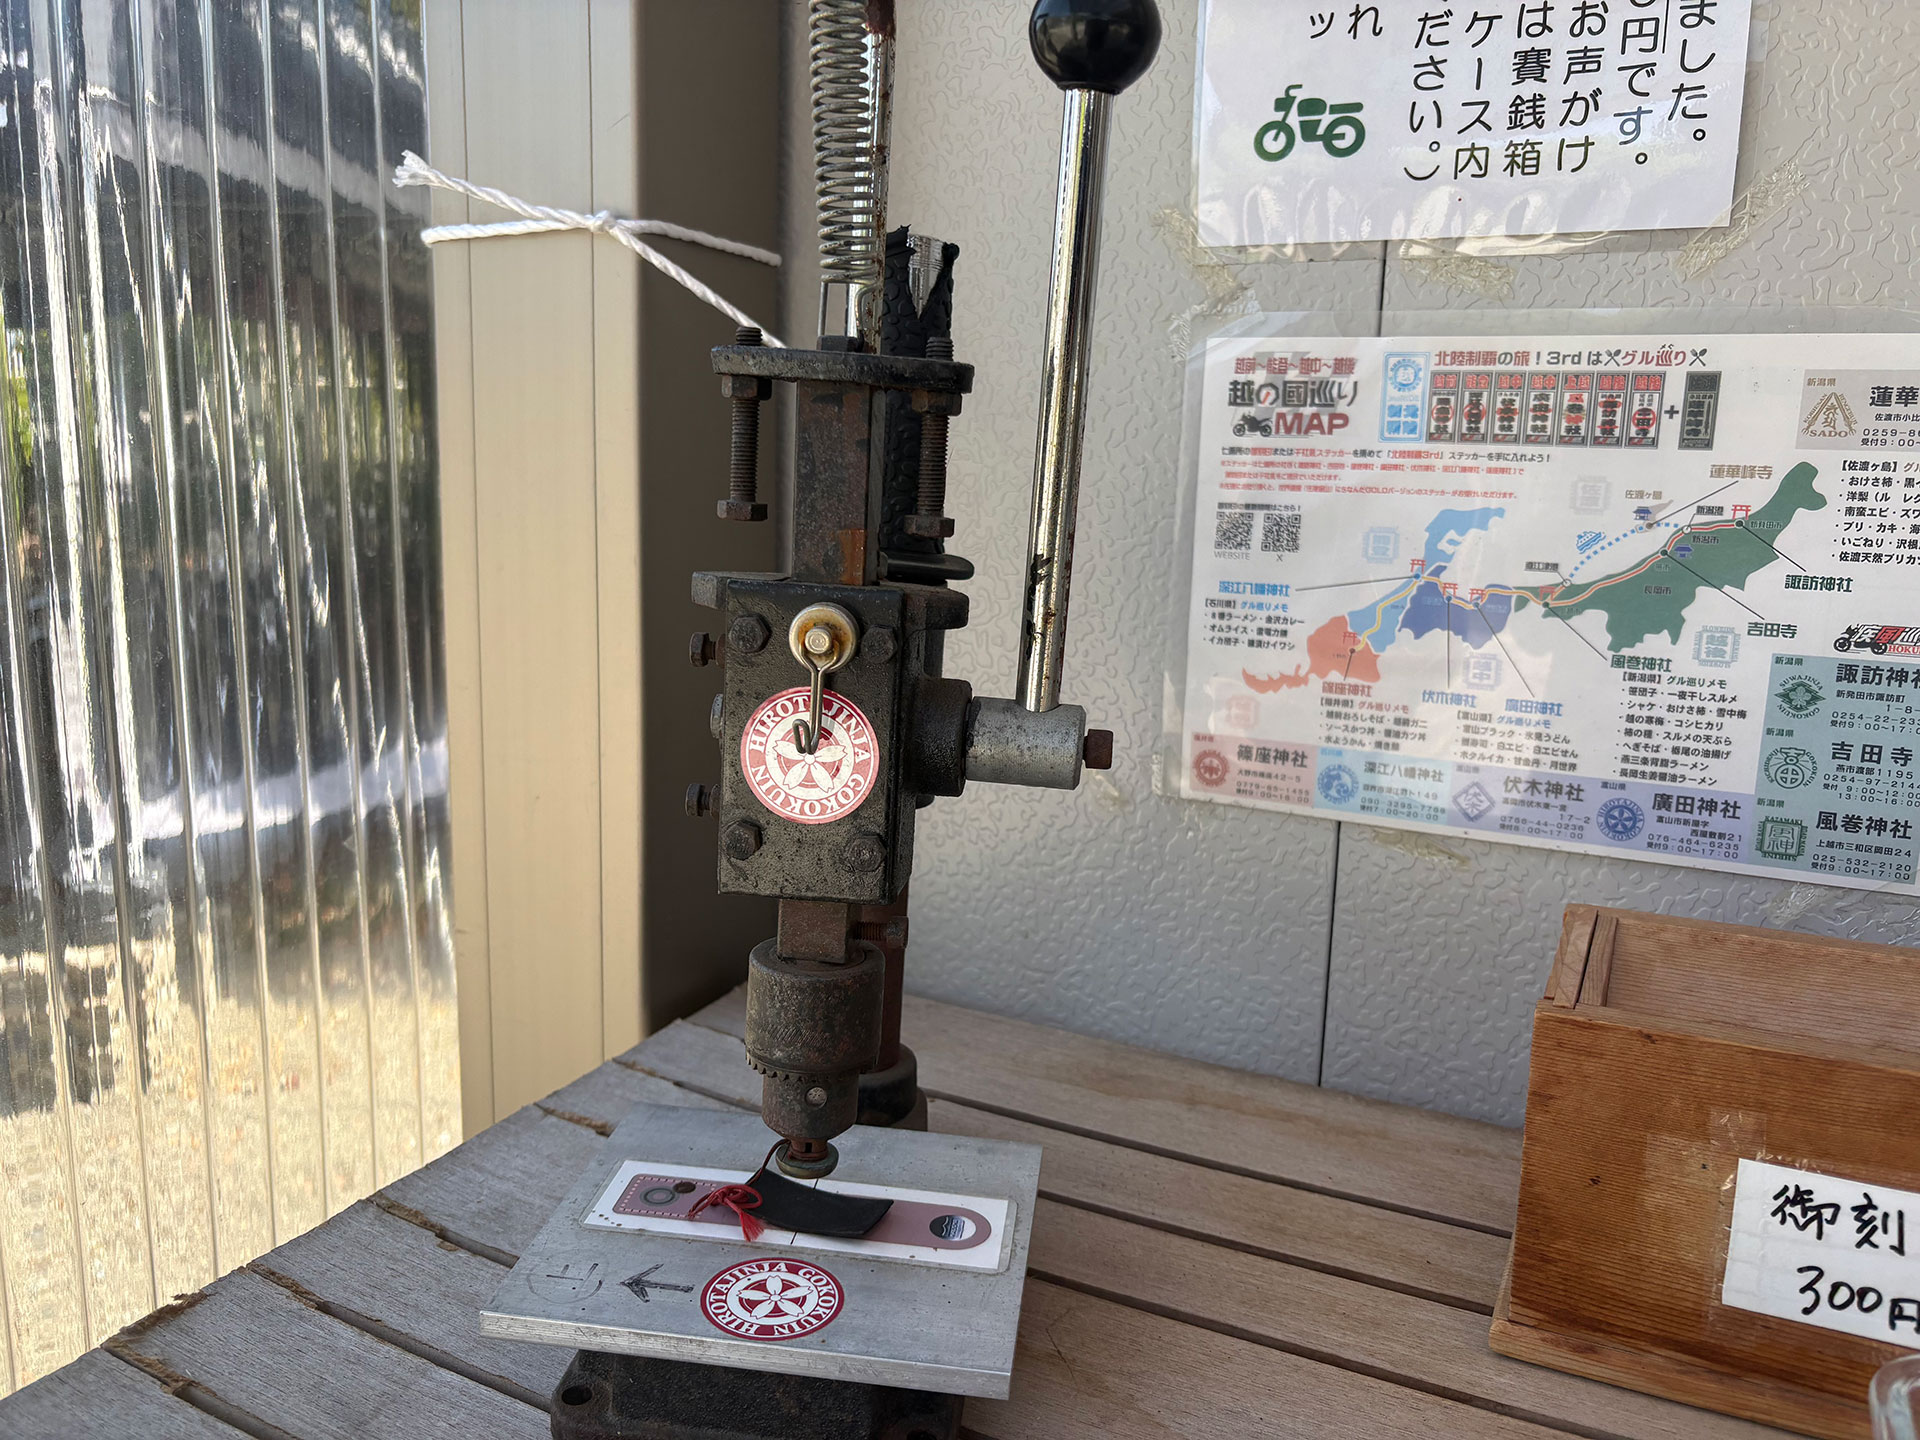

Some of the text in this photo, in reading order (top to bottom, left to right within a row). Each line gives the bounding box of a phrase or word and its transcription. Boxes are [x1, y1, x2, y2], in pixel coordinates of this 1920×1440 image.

[1667, 0, 1718, 141] ました。
[1503, 0, 1555, 177] は賽銭箱
[1557, 0, 1609, 173] お声がけ
[1613, 0, 1660, 165] 円です。
[1453, 11, 1502, 180] ケース内
[1807, 377, 1836, 387] 新潟県
[1228, 380, 1358, 407] 越の國巡り
[1869, 385, 1920, 407] 蓮華
[1274, 412, 1349, 435] MAP
[1808, 430, 1849, 438] SADO
[1862, 428, 1920, 438] 0259-8
[1709, 464, 1773, 480] 蓮華峰寺
[1214, 551, 1250, 561] WEBSITE
[1831, 550, 1920, 566] ・佐渡天然ブリカ
[1784, 574, 1854, 593] 諏訪神社
[1747, 621, 1798, 639] 吉田寺
[1888, 645, 1920, 655] HOKU
[1611, 654, 1672, 673] 風巻神社
[1775, 656, 1803, 667] 新潟県
[1422, 689, 1477, 709] 伏木神社
[1836, 689, 1906, 703] 新発田市諏訪町
[750, 696, 871, 764] HIROTJINJA
[1766, 728, 1794, 738] 新潟県
[1832, 741, 1913, 767] 吉田寺
[751, 765, 865, 816] GOKOKUIN
[1503, 776, 1584, 803] 伏木神社
[1652, 793, 1741, 820] 廣田神社
[1757, 798, 1785, 808] 新潟県
[1816, 811, 1913, 840] 風巻神社
[1812, 853, 1912, 872] 025-532-2120
[1771, 1184, 1905, 1256] 御刻
[710, 1262, 788, 1336] HIROTAJINJA
[774, 1267, 835, 1336] GOKOKUIN
[1797, 1265, 1920, 1334] 300円
